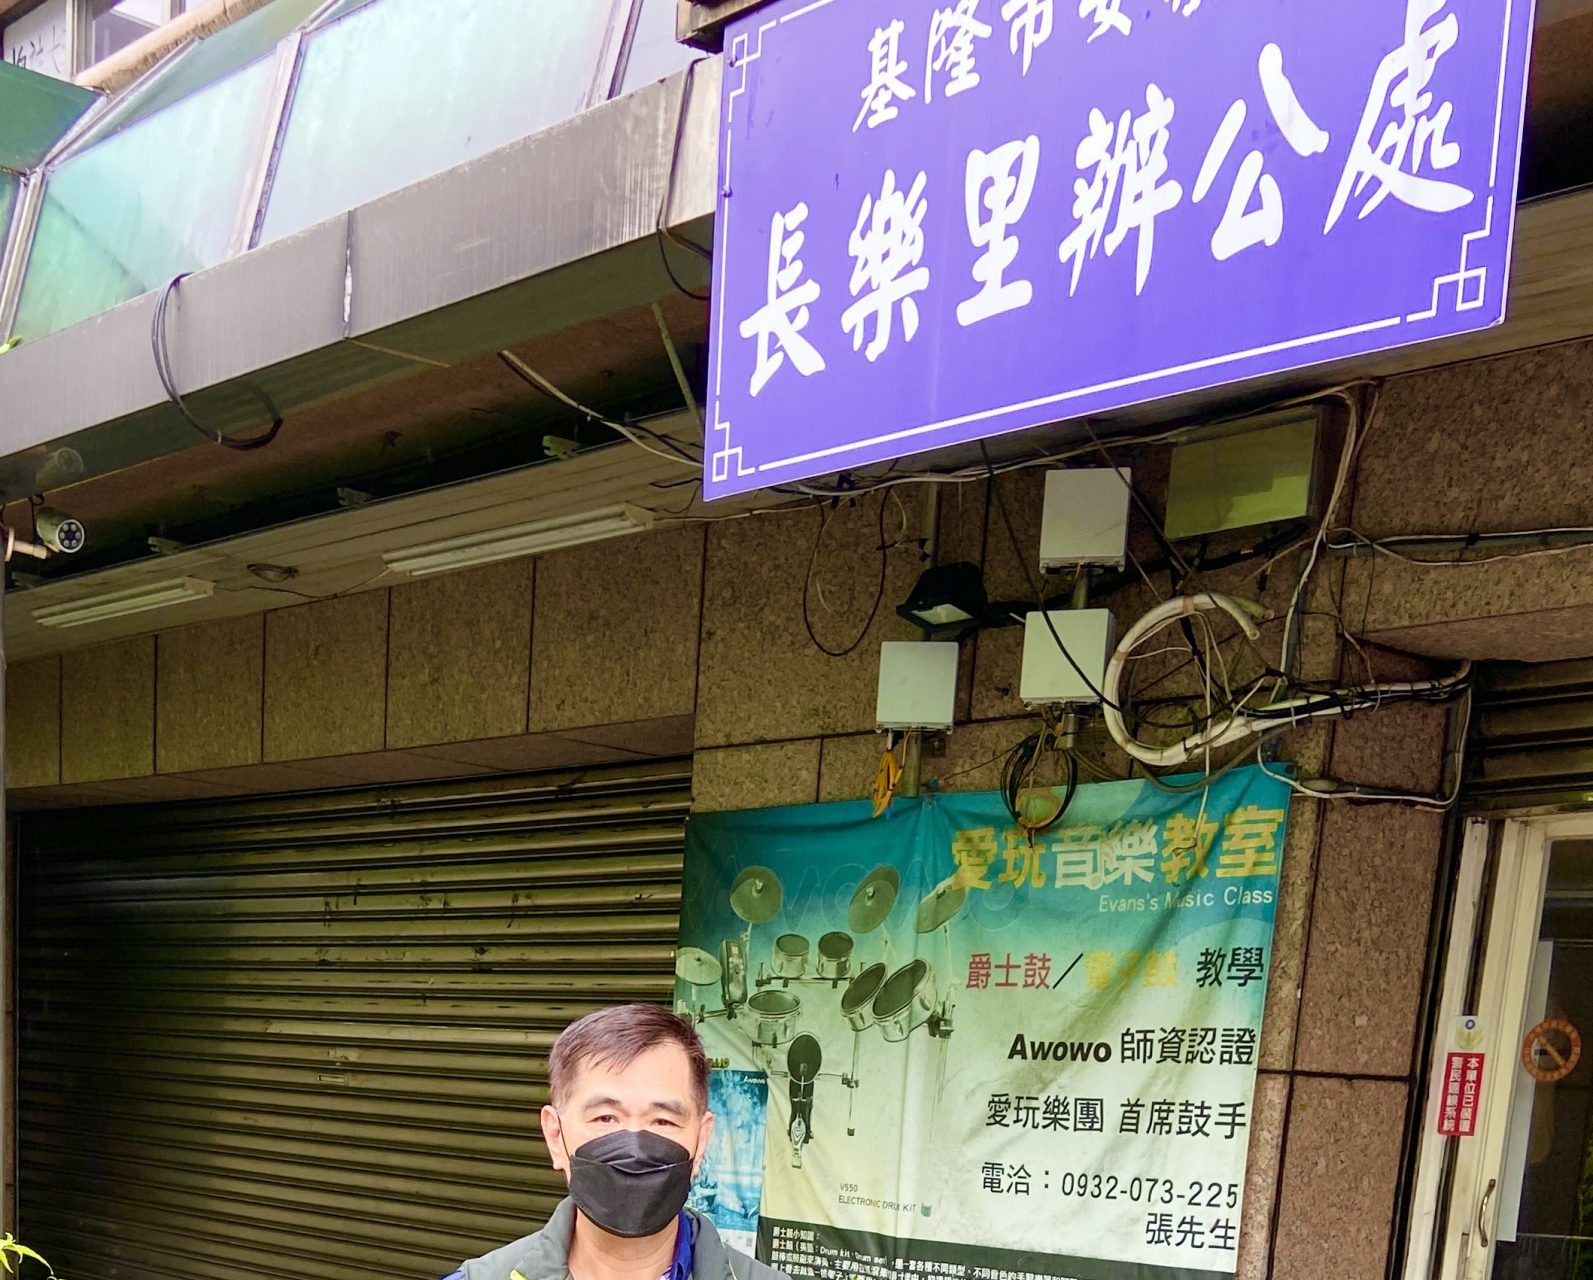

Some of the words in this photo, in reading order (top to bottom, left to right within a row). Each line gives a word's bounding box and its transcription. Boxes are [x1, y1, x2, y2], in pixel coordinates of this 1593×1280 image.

[738, 0, 1474, 398] 長樂里辦公處
[952, 805, 1285, 890] 愛玩音樂教室
[1099, 894, 1158, 913] Evans's
[1164, 891, 1215, 910] Music
[1223, 886, 1273, 906] Class
[1196, 946, 1264, 988] 教學
[1007, 1033, 1112, 1062] Awowo
[1120, 1026, 1256, 1065] 師資認證
[985, 1092, 1104, 1133] 愛玩樂團
[1119, 1097, 1247, 1140] 首席鼓手
[840, 1183, 858, 1192] V550
[902, 1204, 916, 1212] KIT
[1145, 1212, 1237, 1250] 張先生
